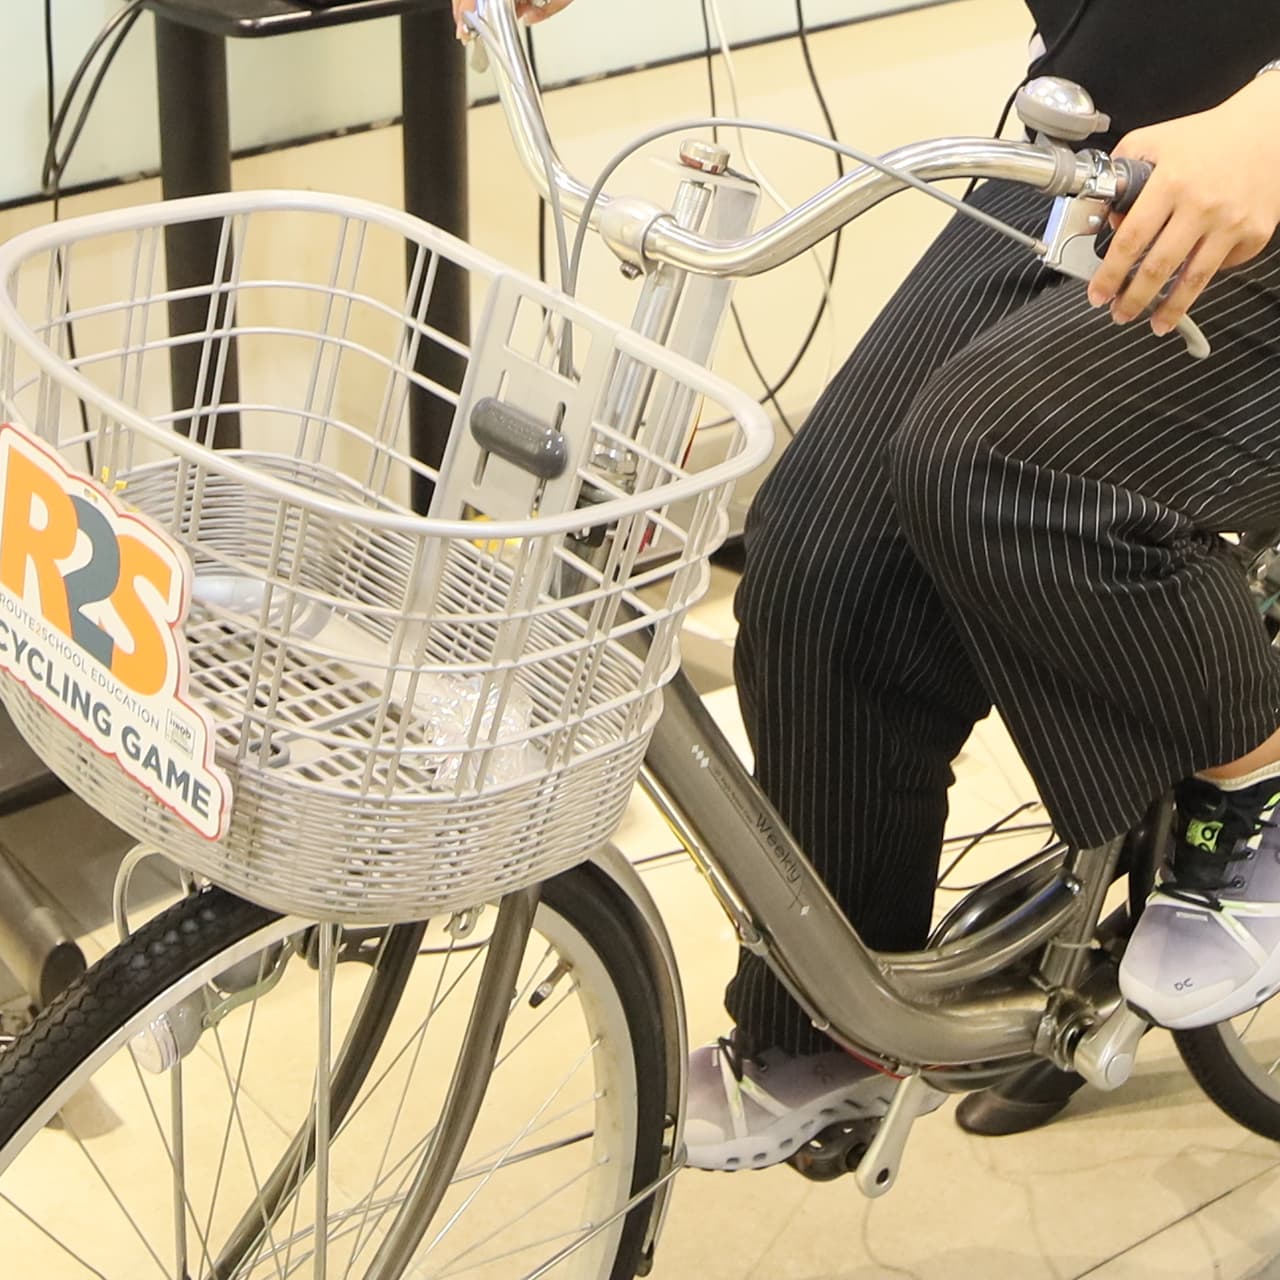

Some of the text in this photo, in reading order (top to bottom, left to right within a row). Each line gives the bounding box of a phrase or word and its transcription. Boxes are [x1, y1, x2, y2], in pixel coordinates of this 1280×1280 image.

[0, 592, 160, 731] ROUTE2SCHOOL EDUCATION
[121, 726, 211, 818] GAME
[756, 813, 800, 883] Weekly
